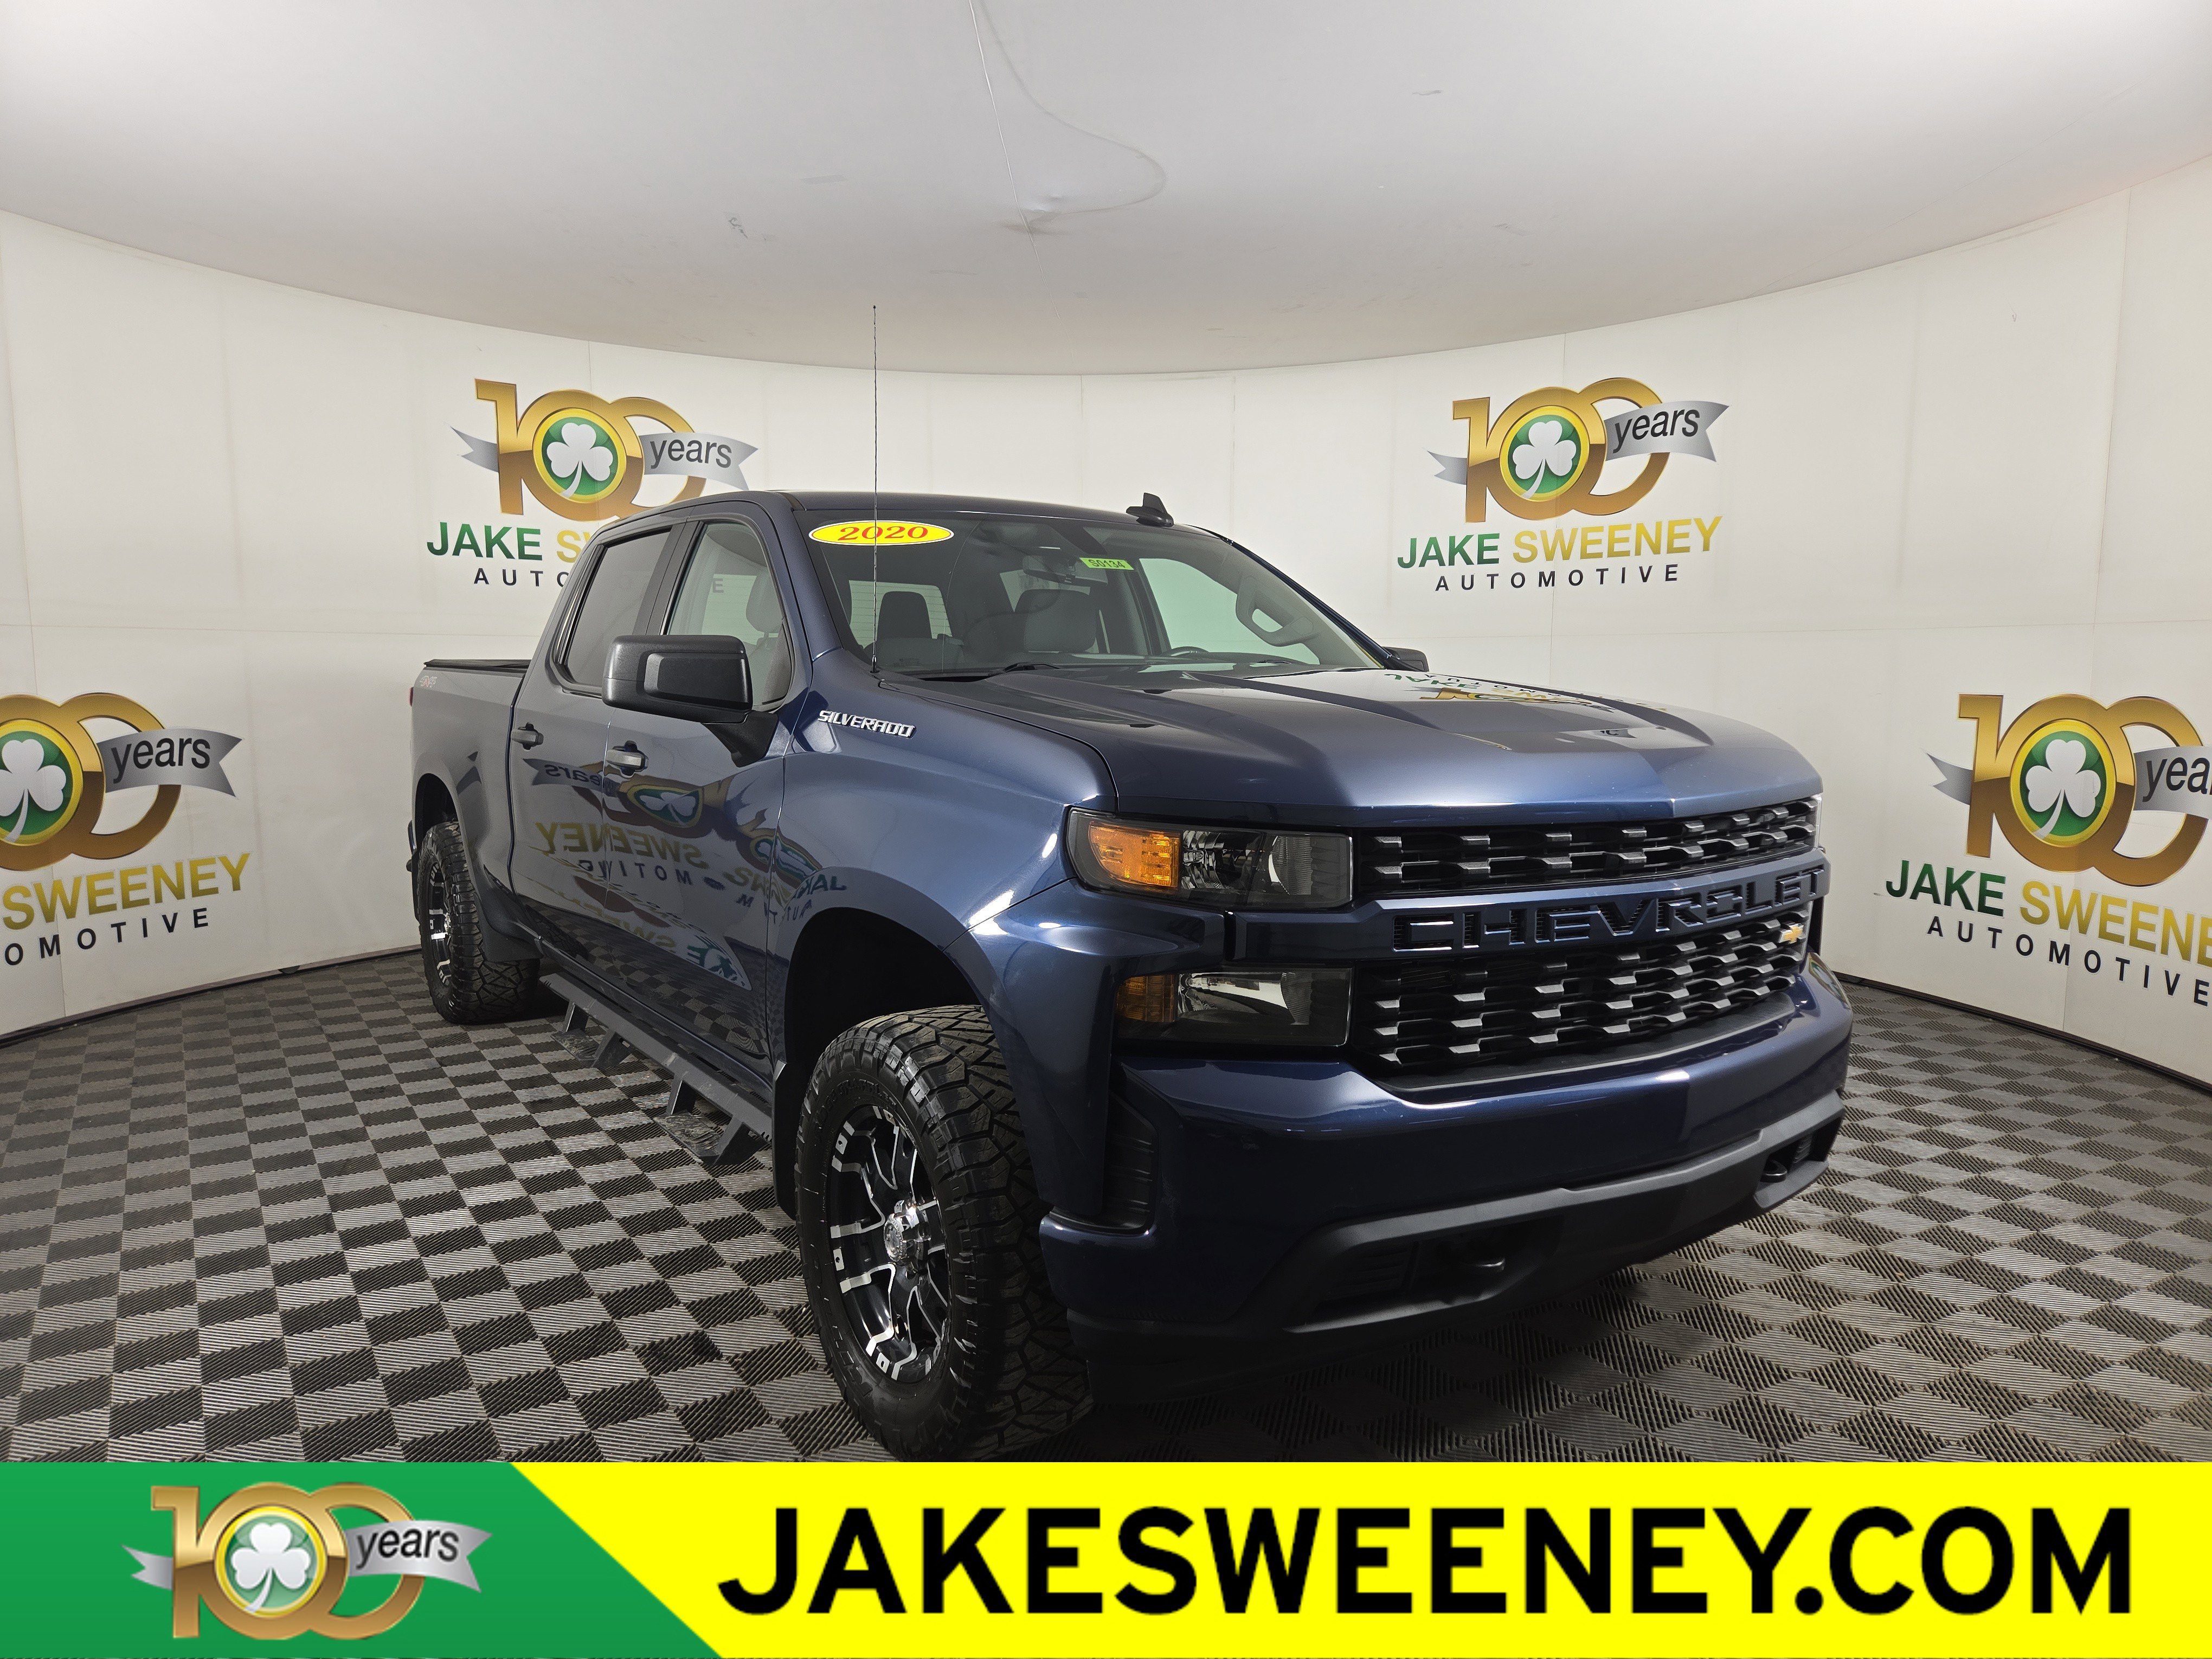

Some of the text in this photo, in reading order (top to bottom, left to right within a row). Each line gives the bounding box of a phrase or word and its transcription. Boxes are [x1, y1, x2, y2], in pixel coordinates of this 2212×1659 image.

[650, 439, 732, 468] years
[1452, 377, 1700, 523] 100 years
[427, 522, 543, 561] JAKE
[838, 526, 928, 541] 2020
[1397, 516, 1723, 569] JAKE SWEENEY
[1435, 564, 1679, 591] AUTOMOTIVE
[818, 710, 916, 738] SILVERADO
[111, 737, 211, 783] years
[2142, 757, 2212, 802] yea
[2, 853, 250, 930] SWEENEY
[1392, 866, 1826, 952] CHEVROLET
[1886, 860, 2007, 917] JAKE
[4, 908, 209, 966] OMOTIVE
[1927, 916, 2210, 1006] AUTOMOTIVE
